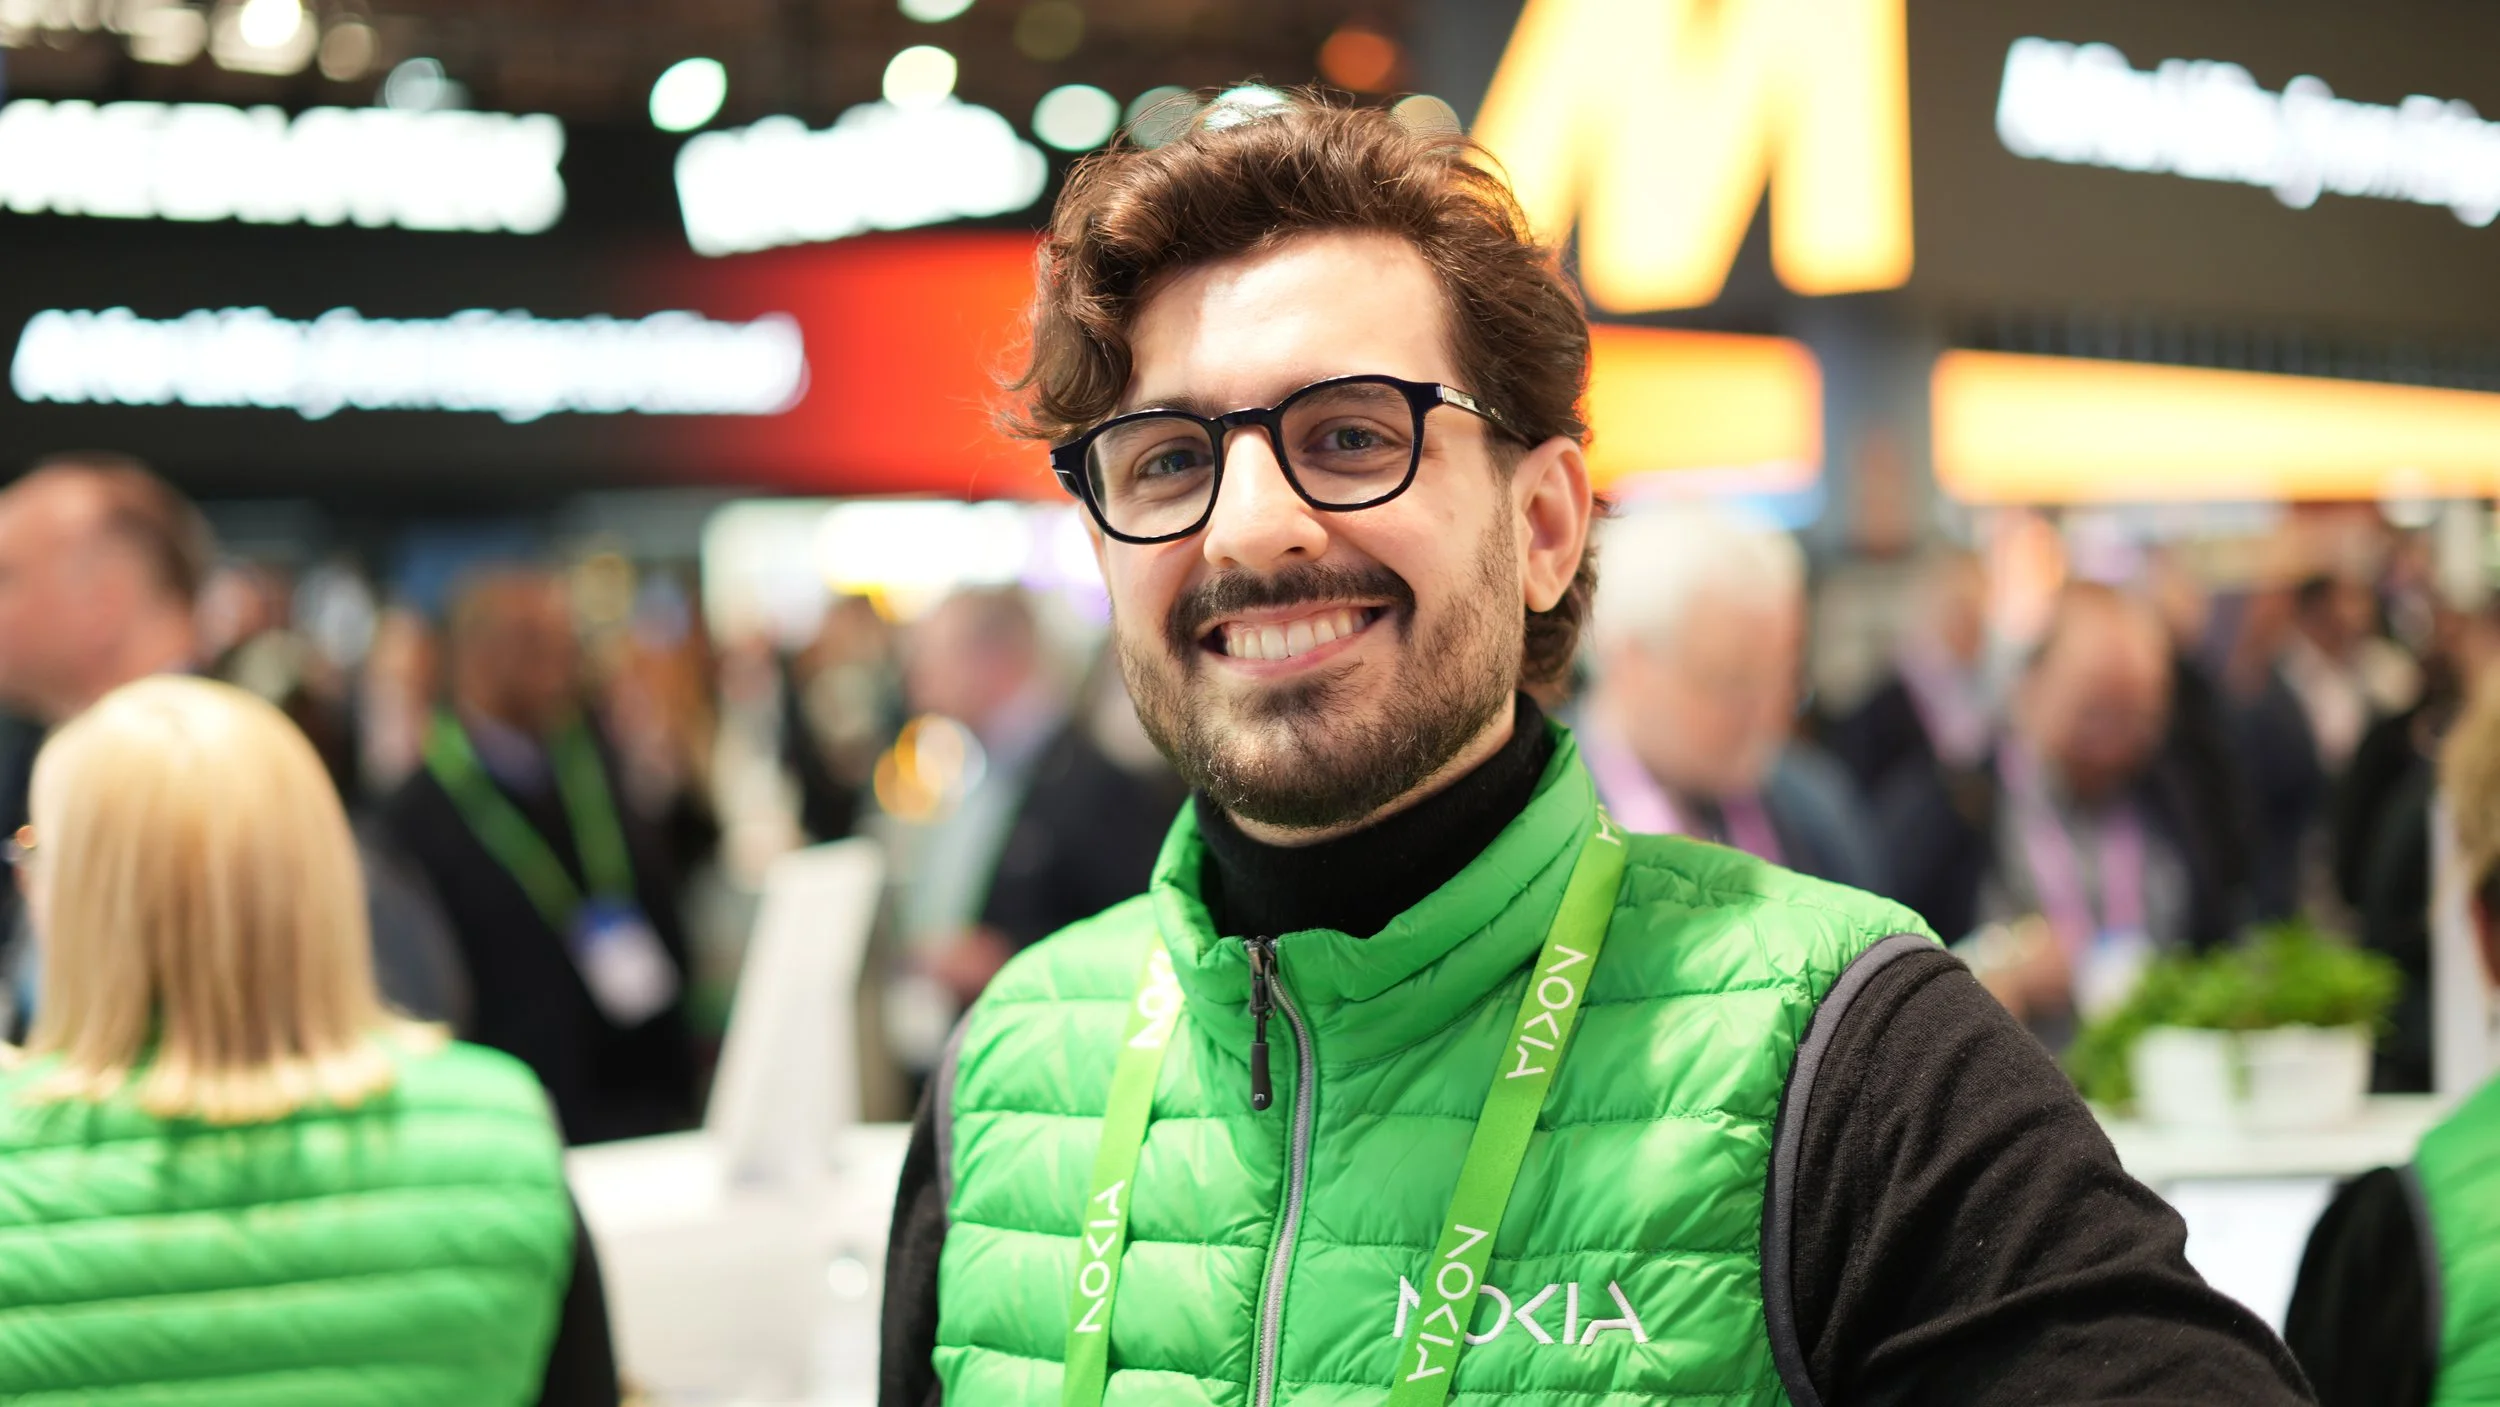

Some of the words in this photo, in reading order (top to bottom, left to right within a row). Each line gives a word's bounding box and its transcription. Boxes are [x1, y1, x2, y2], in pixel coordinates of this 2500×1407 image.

[1127, 949, 1180, 1048] NOK
[1505, 943, 1589, 1080] NOKIA
[1074, 1179, 1127, 1333] NOKIA
[1406, 1223, 1490, 1383] NOKIA
